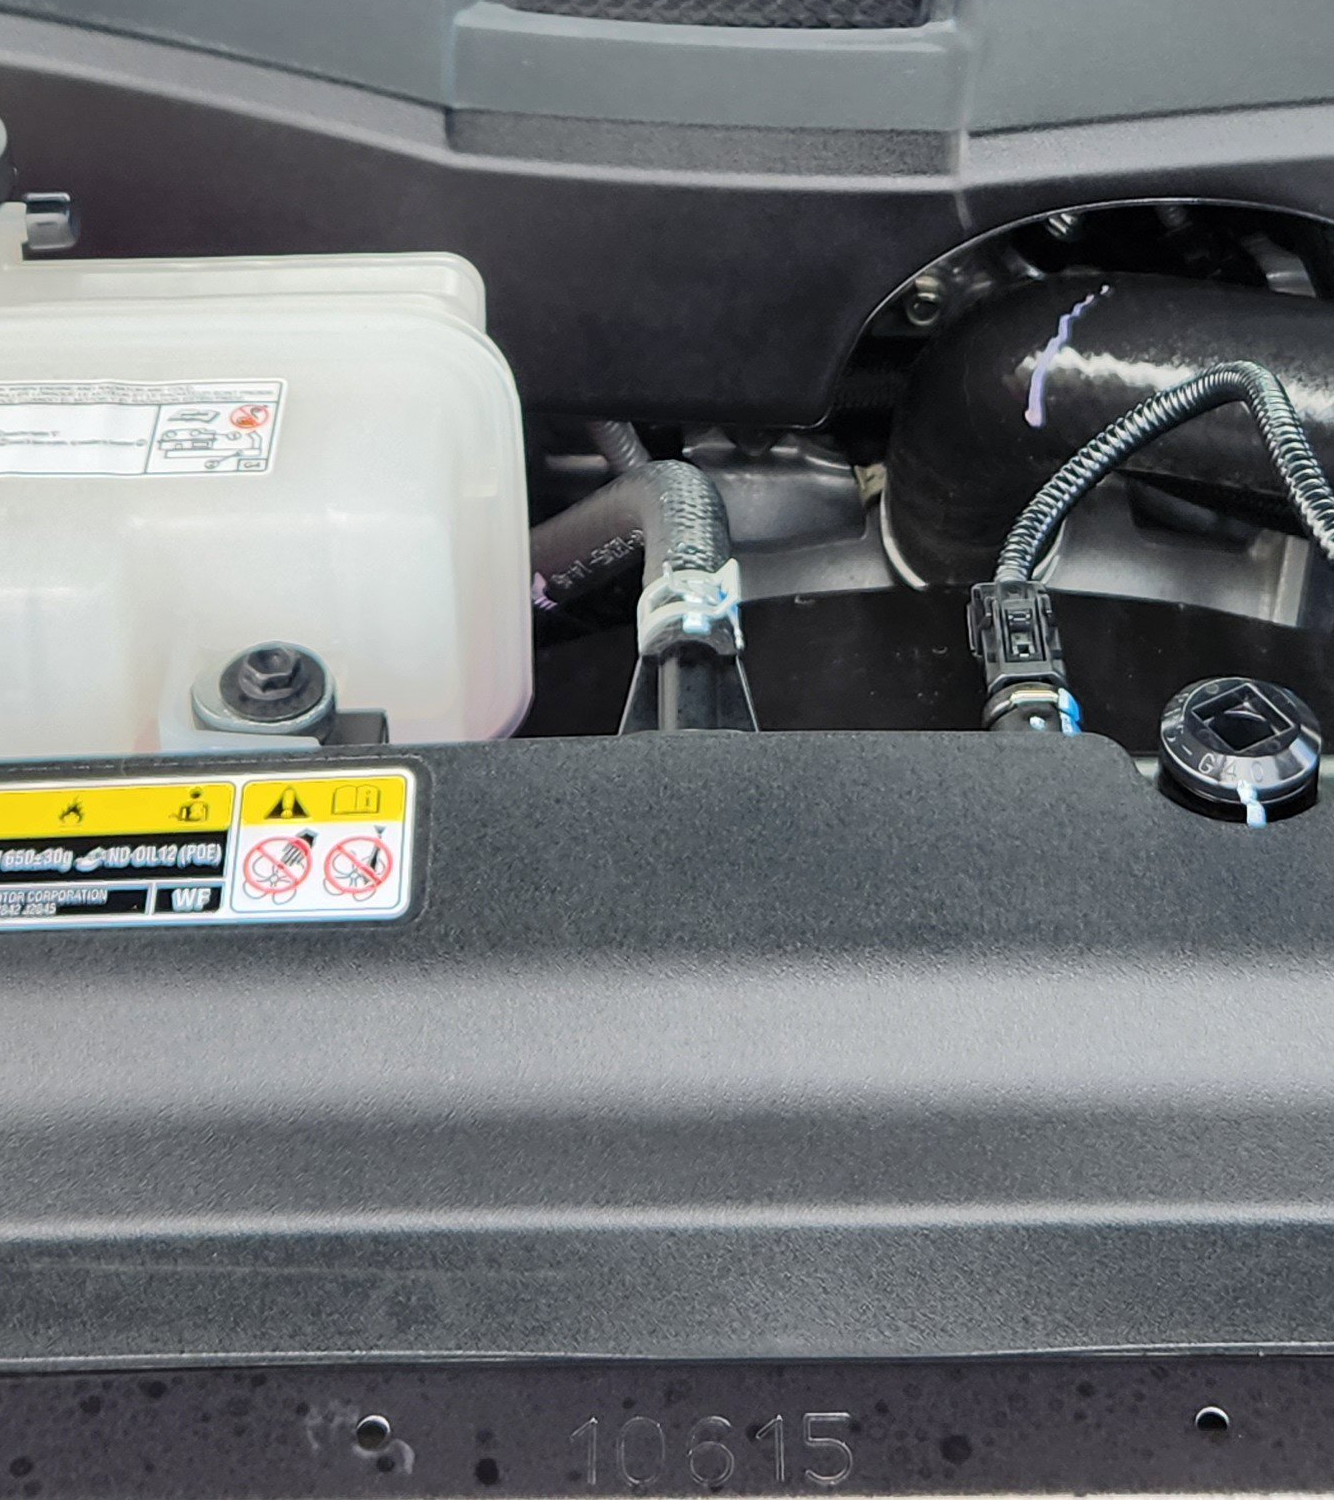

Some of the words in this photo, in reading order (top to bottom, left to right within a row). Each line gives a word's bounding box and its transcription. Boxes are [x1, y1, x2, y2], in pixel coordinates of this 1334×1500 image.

[3, 847, 74, 873] 650±30g
[178, 843, 223, 869] (POE)
[27, 888, 109, 905] CORPORATION
[171, 888, 212, 913] WF
[567, 1411, 855, 1487] 10615
